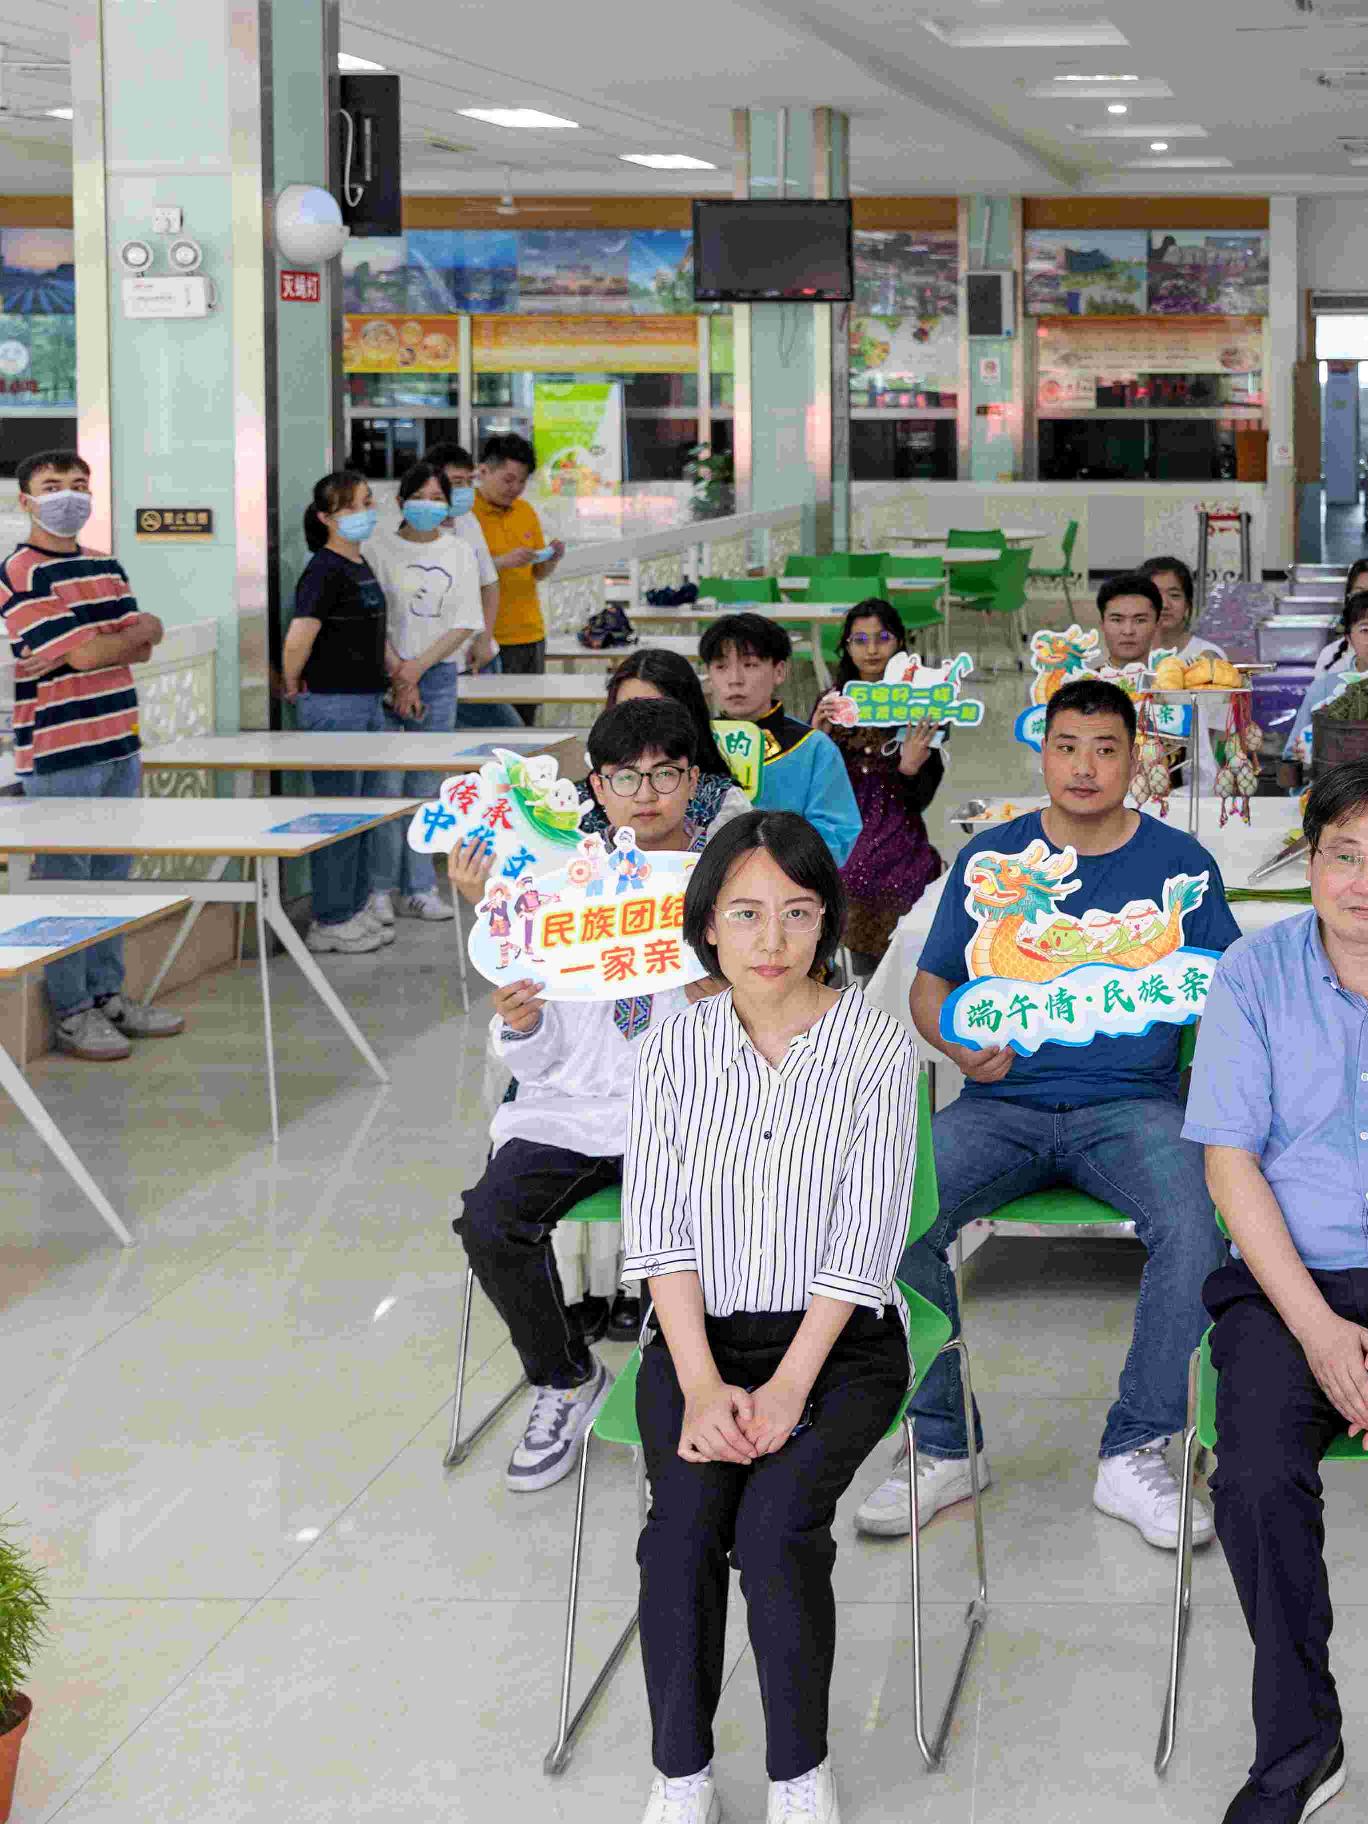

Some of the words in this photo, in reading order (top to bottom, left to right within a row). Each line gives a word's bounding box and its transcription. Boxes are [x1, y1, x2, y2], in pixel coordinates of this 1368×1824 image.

[448, 780, 513, 829] 传承
[542, 893, 685, 948] 民族团结
[559, 937, 682, 982] 一家亲
